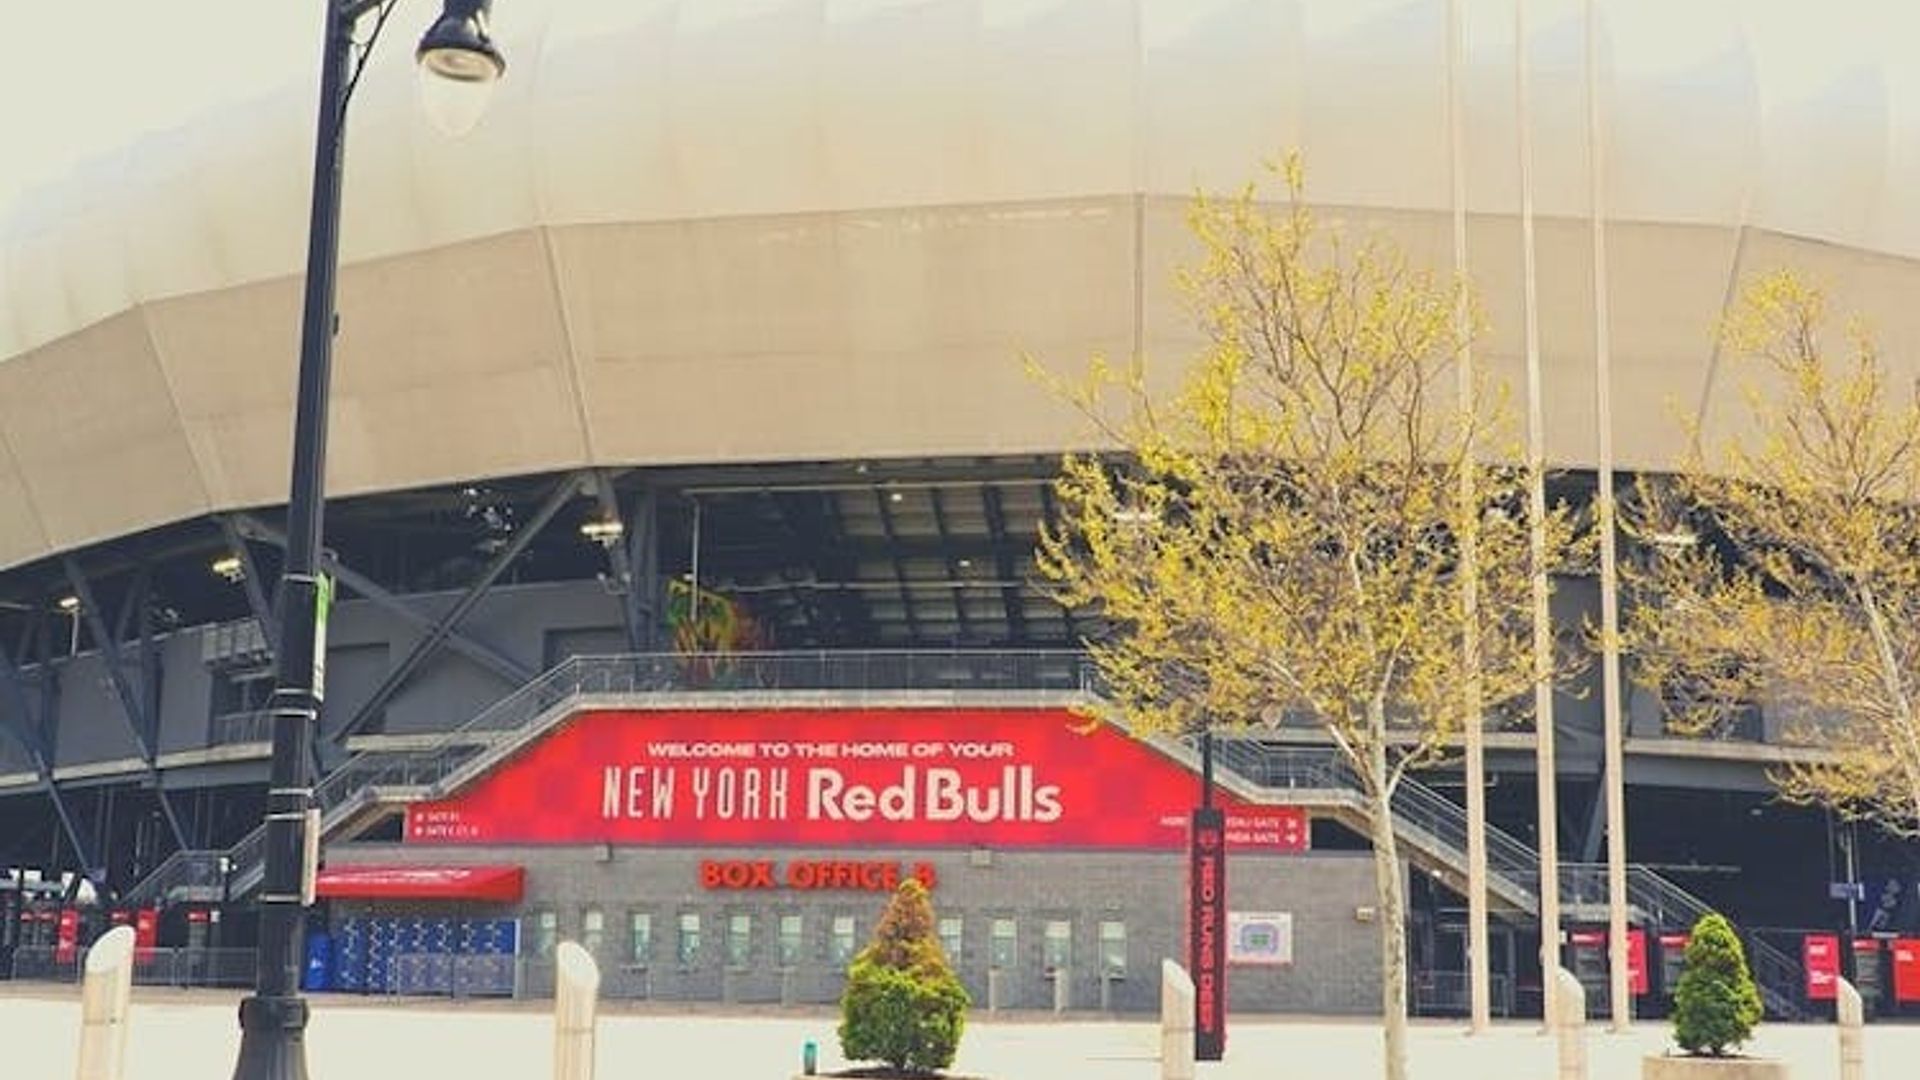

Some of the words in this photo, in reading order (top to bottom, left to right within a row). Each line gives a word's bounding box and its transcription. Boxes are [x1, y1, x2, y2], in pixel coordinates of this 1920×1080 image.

[648, 742, 755, 757] WELCOME
[759, 742, 790, 757] TO
[794, 742, 838, 757] THE
[842, 742, 908, 757] HOME
[912, 742, 943, 757] OF
[949, 742, 1013, 757] YOUR
[603, 767, 675, 819] NEW
[693, 767, 788, 819] YORK
[807, 765, 916, 821] Red
[926, 765, 1062, 822] Bulls
[701, 860, 773, 889] BOX
[787, 860, 898, 891] OFFICE
[1201, 857, 1215, 902] RED
[1201, 906, 1215, 970] RUNS
